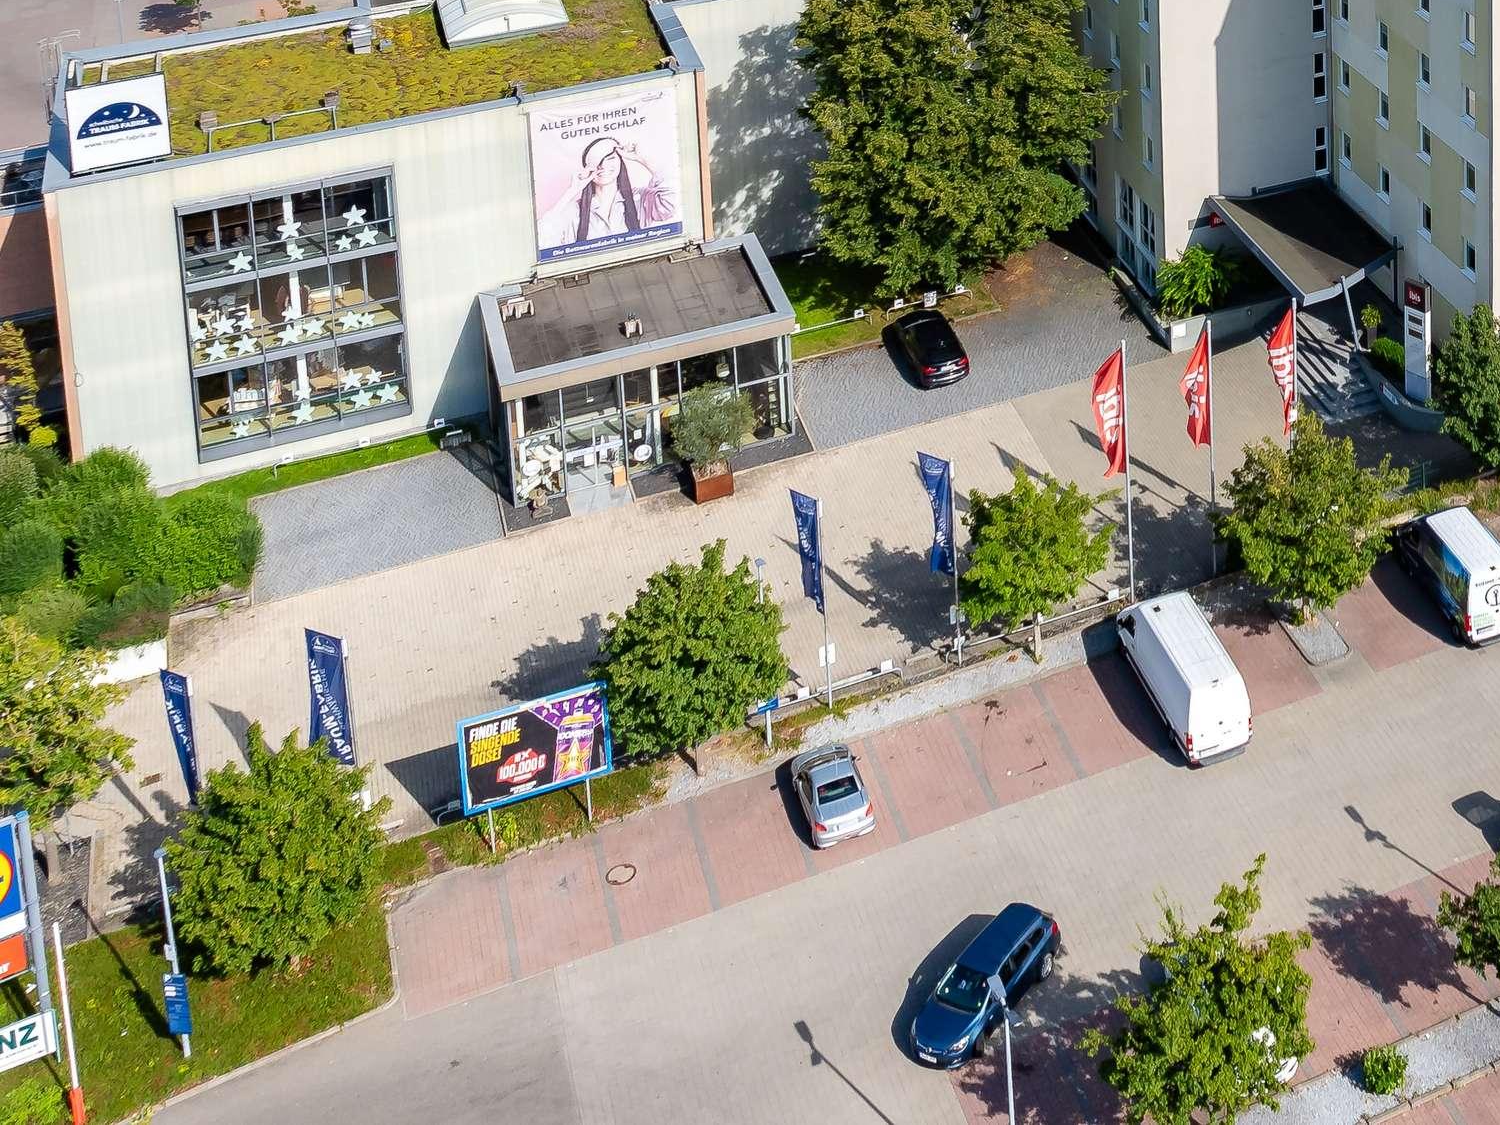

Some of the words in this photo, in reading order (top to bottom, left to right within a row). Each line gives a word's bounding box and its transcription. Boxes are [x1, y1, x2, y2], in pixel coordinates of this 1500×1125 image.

[540, 118, 574, 132] ALLES
[577, 113, 599, 125] FÜR
[602, 106, 637, 121] IHREN
[560, 125, 600, 140] GUTEN
[603, 116, 647, 132] SCHLAF
[1409, 290, 1421, 302] ibis
[469, 722, 499, 742] FINDE
[500, 716, 520, 733] DIE
[470, 729, 521, 756] SINGENDE
[0, 1022, 39, 1050] NZ
